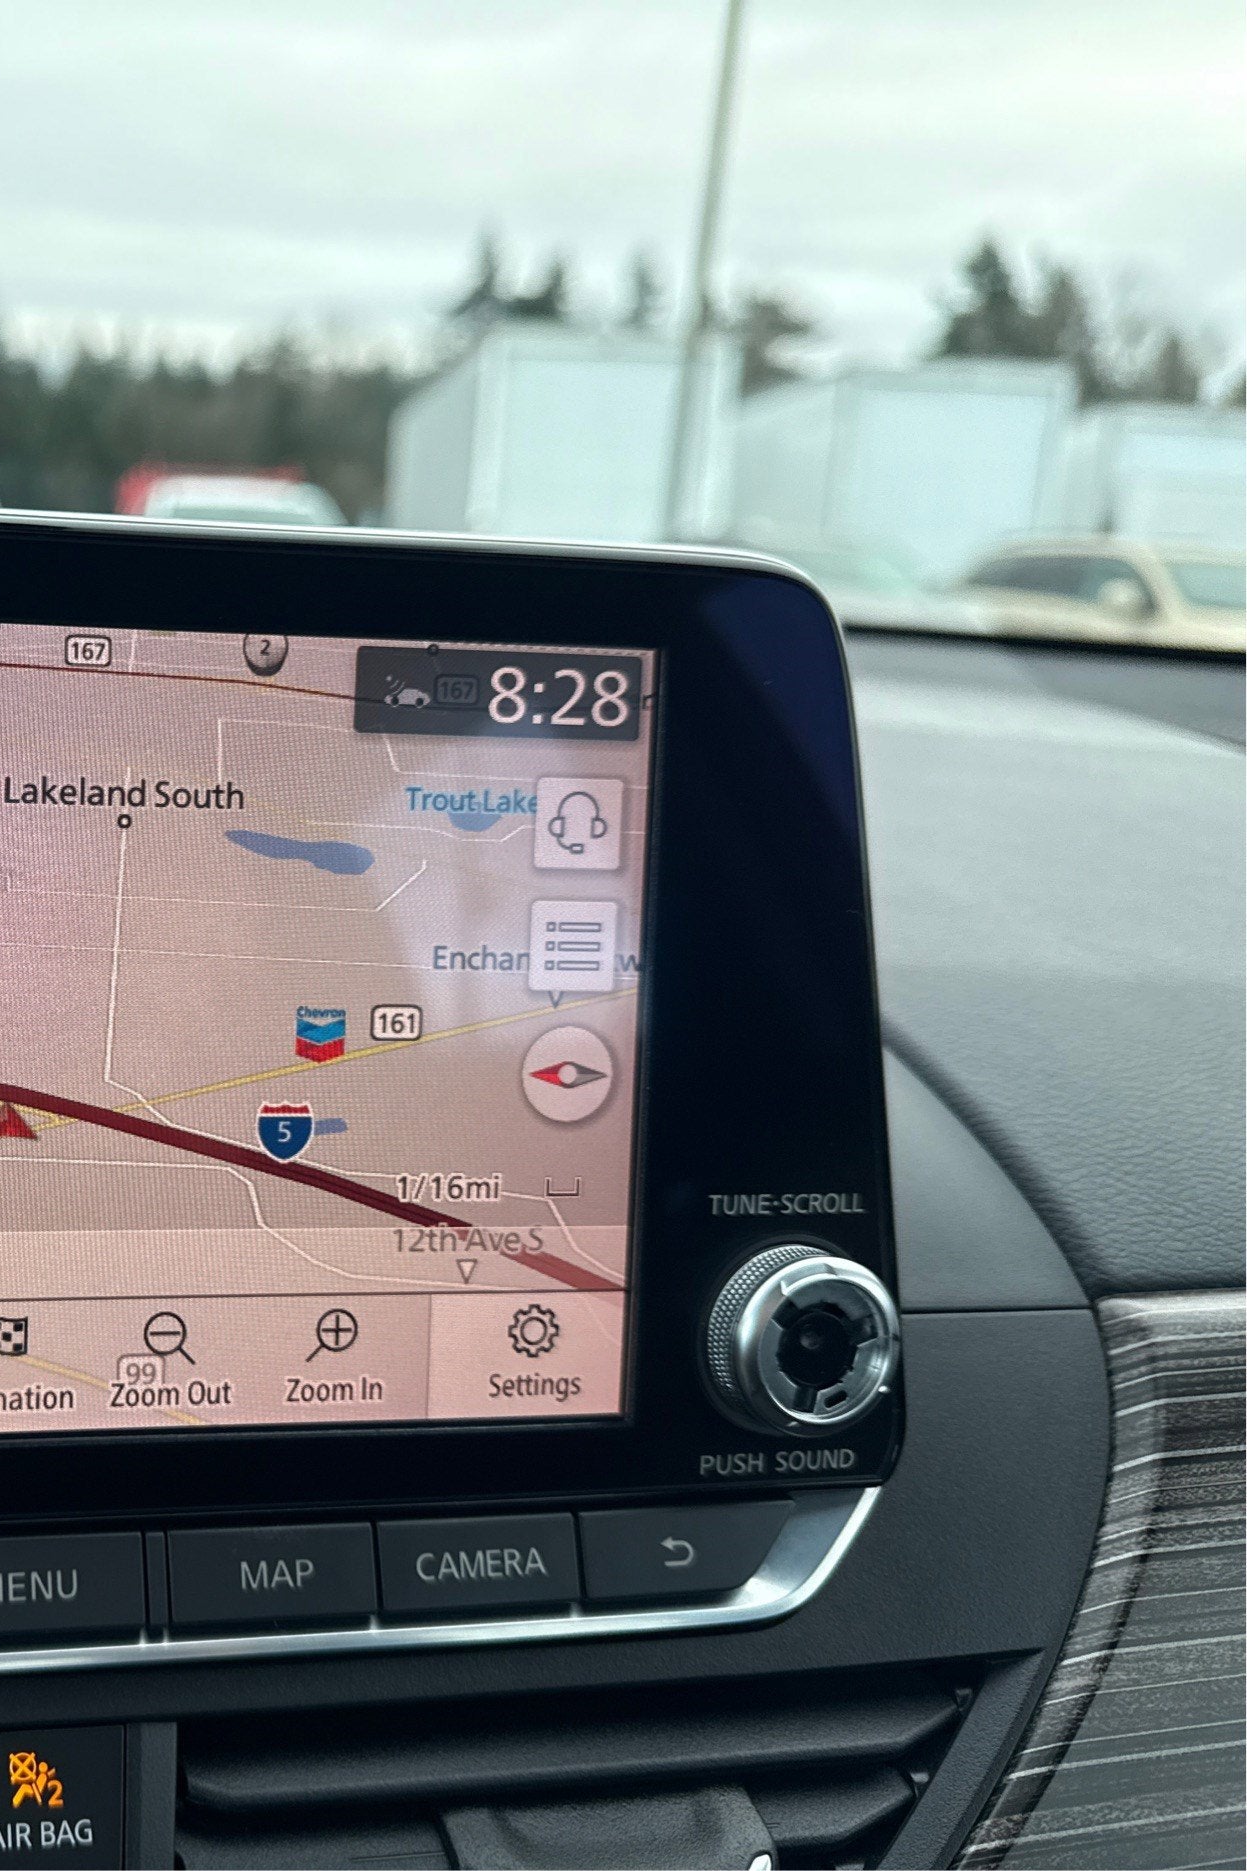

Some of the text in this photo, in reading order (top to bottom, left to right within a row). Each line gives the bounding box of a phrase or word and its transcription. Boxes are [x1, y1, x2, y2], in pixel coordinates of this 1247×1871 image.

[71, 642, 105, 660] 167
[260, 640, 271, 657] 2
[439, 680, 473, 700] 167
[488, 666, 629, 727] 8:28
[4, 777, 245, 810] Lakeland South
[407, 786, 538, 814] Trout Lake
[297, 1005, 346, 1018] Chevron
[379, 1013, 416, 1034] 161
[278, 1121, 291, 1142] 5
[398, 1175, 501, 1200] 1/16mi
[393, 1226, 544, 1252] 12th Ave S
[126, 1362, 157, 1385] 99
[488, 1371, 582, 1402] Settings
[111, 1380, 232, 1407] Zoom Out
[286, 1376, 383, 1402] Zoom In
[699, 1447, 856, 1476] PUSH SOUND
[240, 1560, 315, 1591] MAP
[415, 1546, 546, 1581] CAMERA
[40, 1818, 93, 1848] BAG
